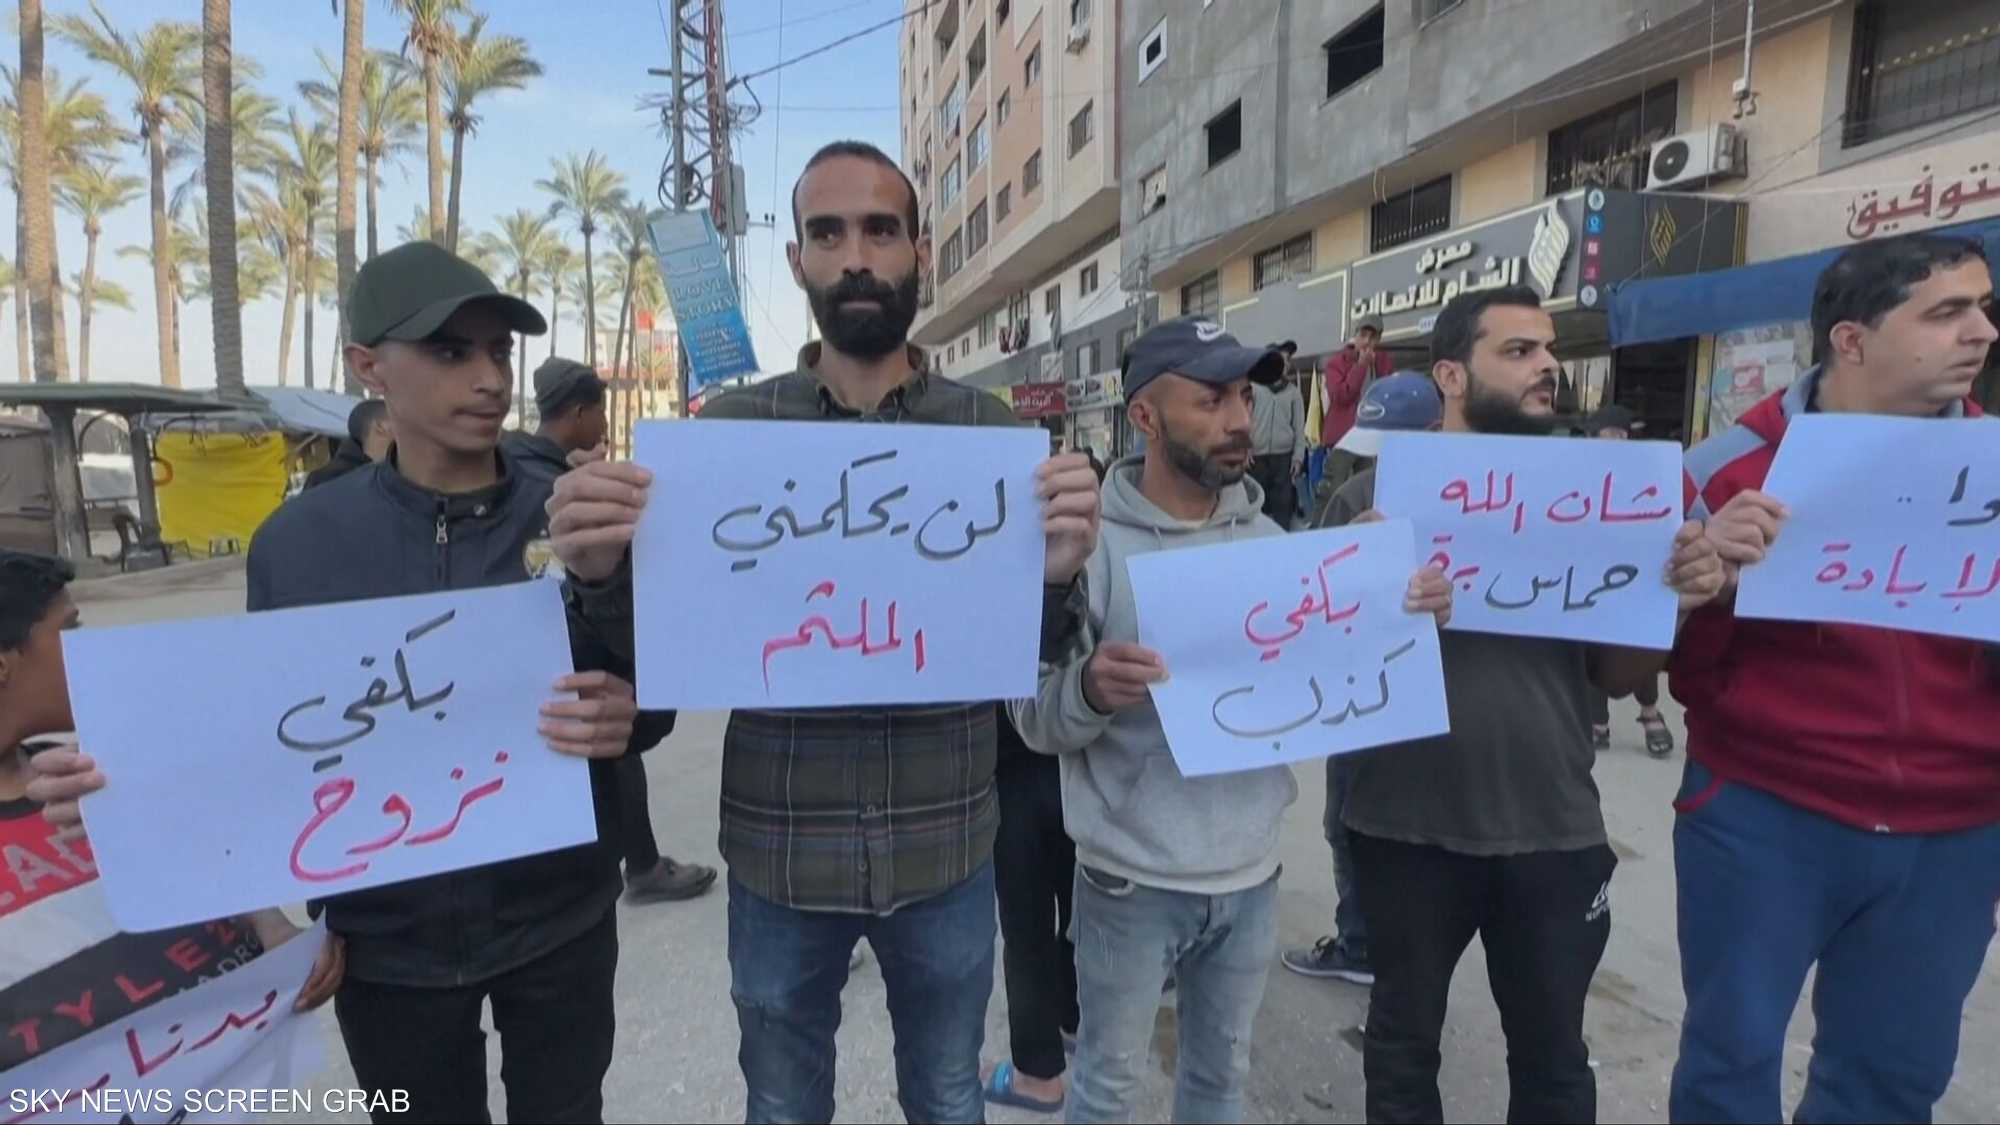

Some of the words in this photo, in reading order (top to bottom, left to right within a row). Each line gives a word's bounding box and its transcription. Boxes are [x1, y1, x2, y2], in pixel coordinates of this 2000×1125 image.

[1442, 255, 1521, 308] الشام
[711, 449, 911, 572] يحكمني
[914, 476, 1006, 561] لن
[1439, 469, 1525, 535] الله
[761, 580, 926, 696] الملثم
[1244, 542, 1362, 663] بكفي
[1483, 563, 1640, 612] حماس
[276, 608, 457, 773] بكفي
[1211, 637, 1417, 752] كذب
[288, 750, 509, 883] نزوح
